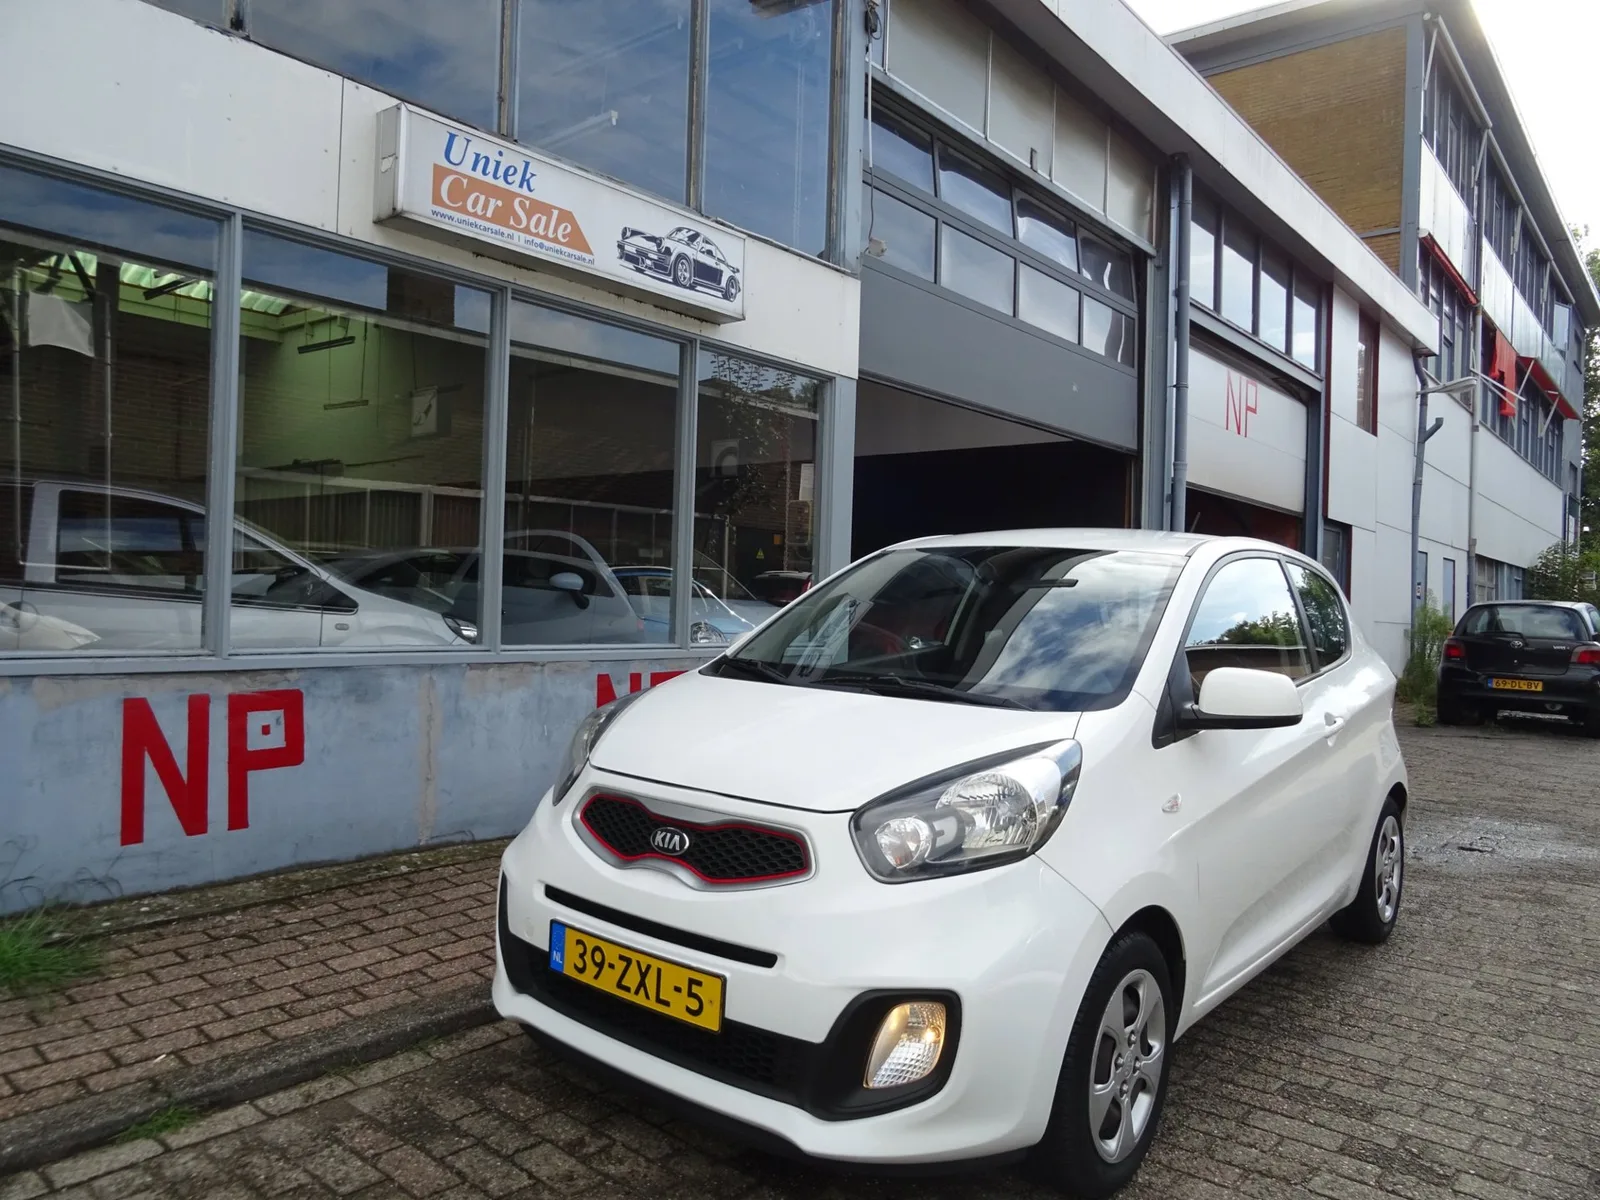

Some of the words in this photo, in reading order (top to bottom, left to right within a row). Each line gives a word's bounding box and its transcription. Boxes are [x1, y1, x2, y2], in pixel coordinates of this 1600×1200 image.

[444, 131, 537, 193] Uniek
[431, 209, 515, 241] www.uniekcarsale.nl
[523, 238, 595, 266] info@uniekcarsale.nl
[440, 174, 503, 219] Car
[509, 197, 572, 243] Sale
[1226, 368, 1258, 438] NP
[120, 688, 305, 847] NP
[654, 830, 680, 851] KIA
[552, 950, 563, 964] NL
[573, 938, 704, 1018] 39-ZXL-5
